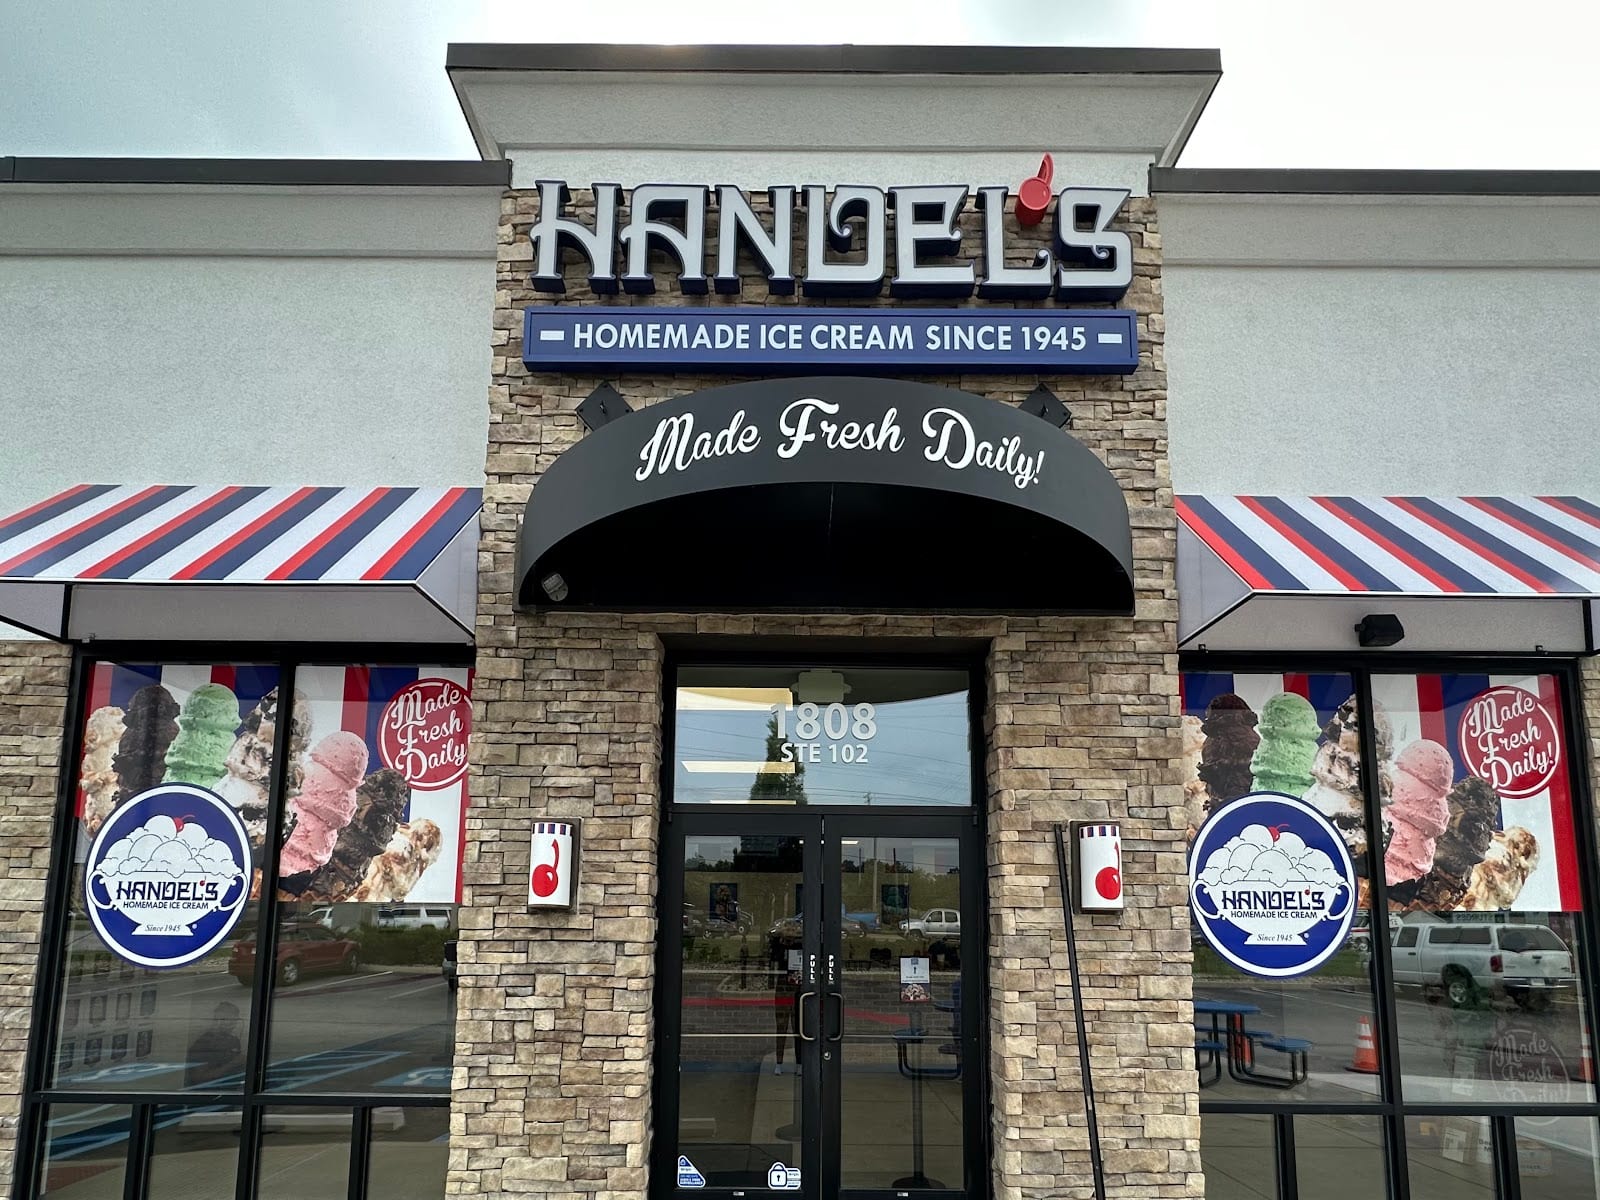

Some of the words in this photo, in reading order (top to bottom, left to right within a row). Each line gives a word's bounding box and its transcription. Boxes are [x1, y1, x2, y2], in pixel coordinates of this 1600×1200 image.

[573, 323, 750, 350] HOMEMADE
[759, 324, 803, 350] ICE
[810, 324, 914, 351] CREAM
[925, 325, 1012, 351] SINCE
[1021, 326, 1087, 352] 1945
[635, 409, 762, 482] Made
[777, 398, 905, 459] Fresh
[921, 407, 1045, 490] Daily!
[390, 683, 462, 729] Made
[770, 702, 877, 740] 1808
[1468, 690, 1536, 738] Made
[397, 709, 464, 756] Fresh
[1477, 717, 1542, 764] Fresh
[780, 742, 821, 763] STE
[828, 743, 869, 763] 102
[1479, 741, 1554, 789] Daily!
[123, 901, 168, 909] HOMEMADE
[182, 902, 209, 910] CREAM
[1230, 910, 1276, 918] HOMEMADE
[1290, 911, 1318, 919] CREAM
[145, 924, 164, 932] Since
[164, 924, 182, 933] 1945
[1256, 933, 1276, 942] Since
[1276, 934, 1293, 942] 1945
